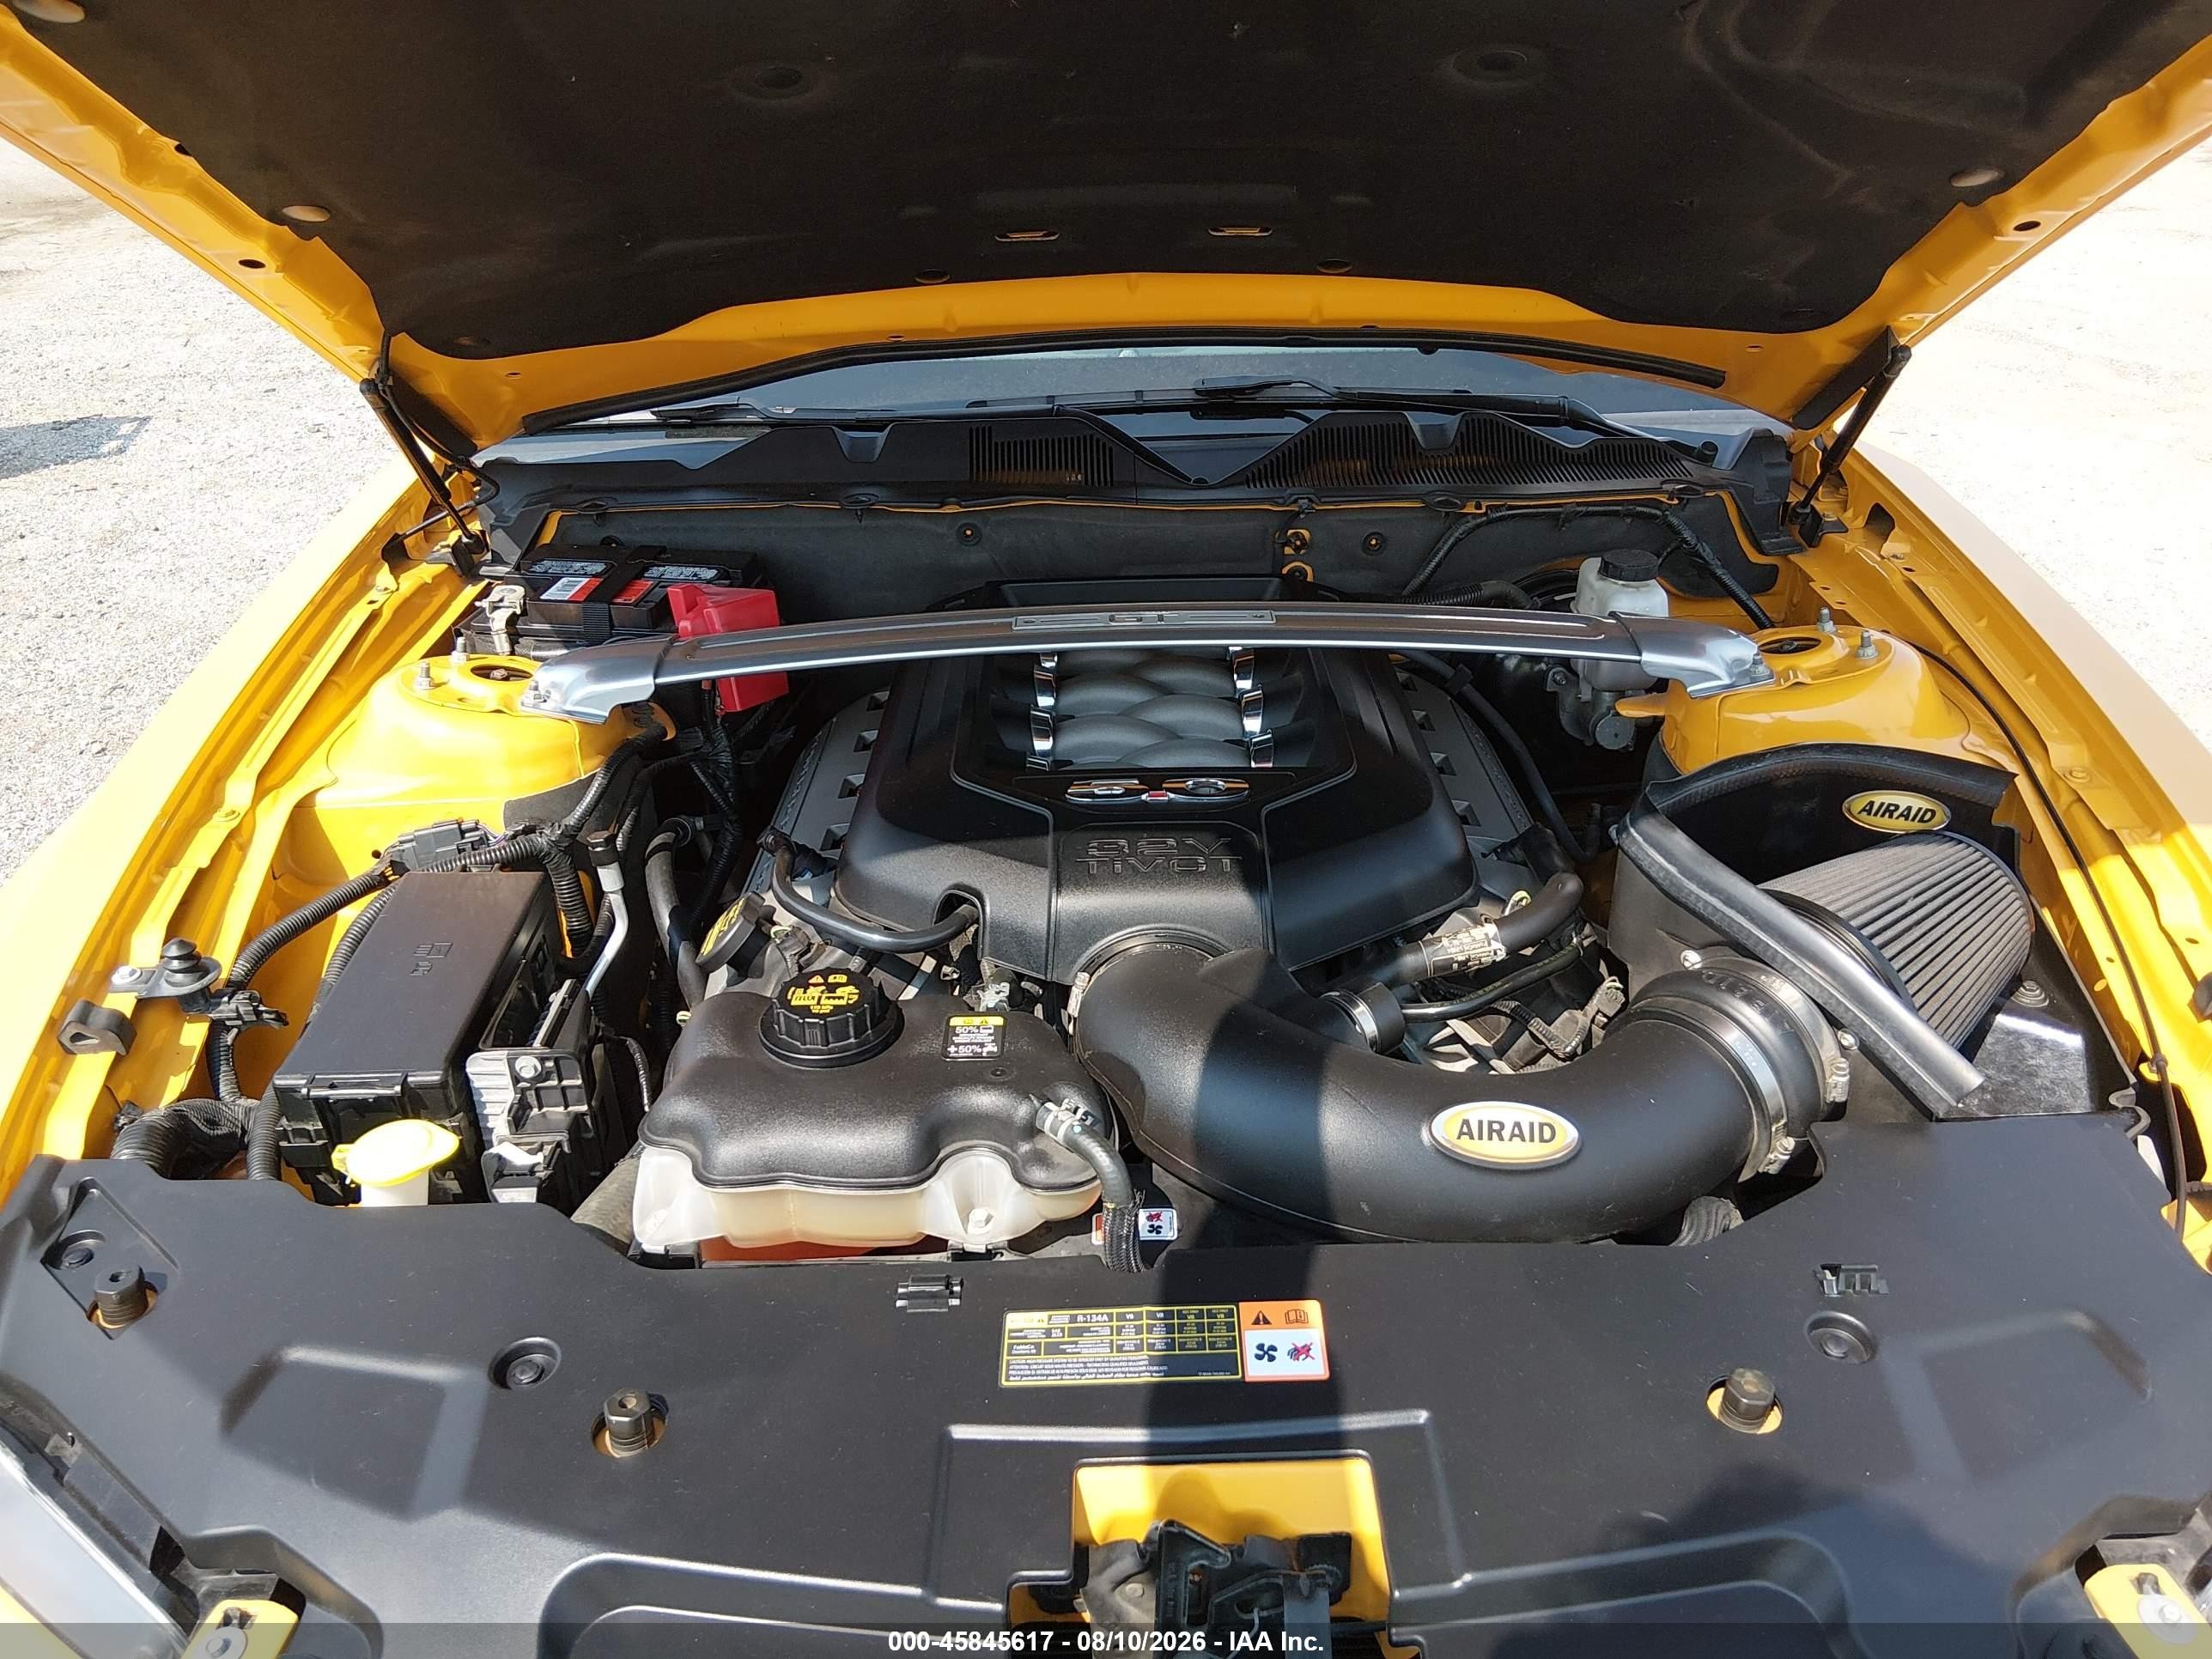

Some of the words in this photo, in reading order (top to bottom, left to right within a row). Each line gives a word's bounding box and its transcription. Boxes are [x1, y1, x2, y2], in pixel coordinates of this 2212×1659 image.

[1857, 799, 1937, 823] AIRAID
[1455, 1118, 1557, 1144] AIRAID
[1077, 1314, 1109, 1322] R-134A
